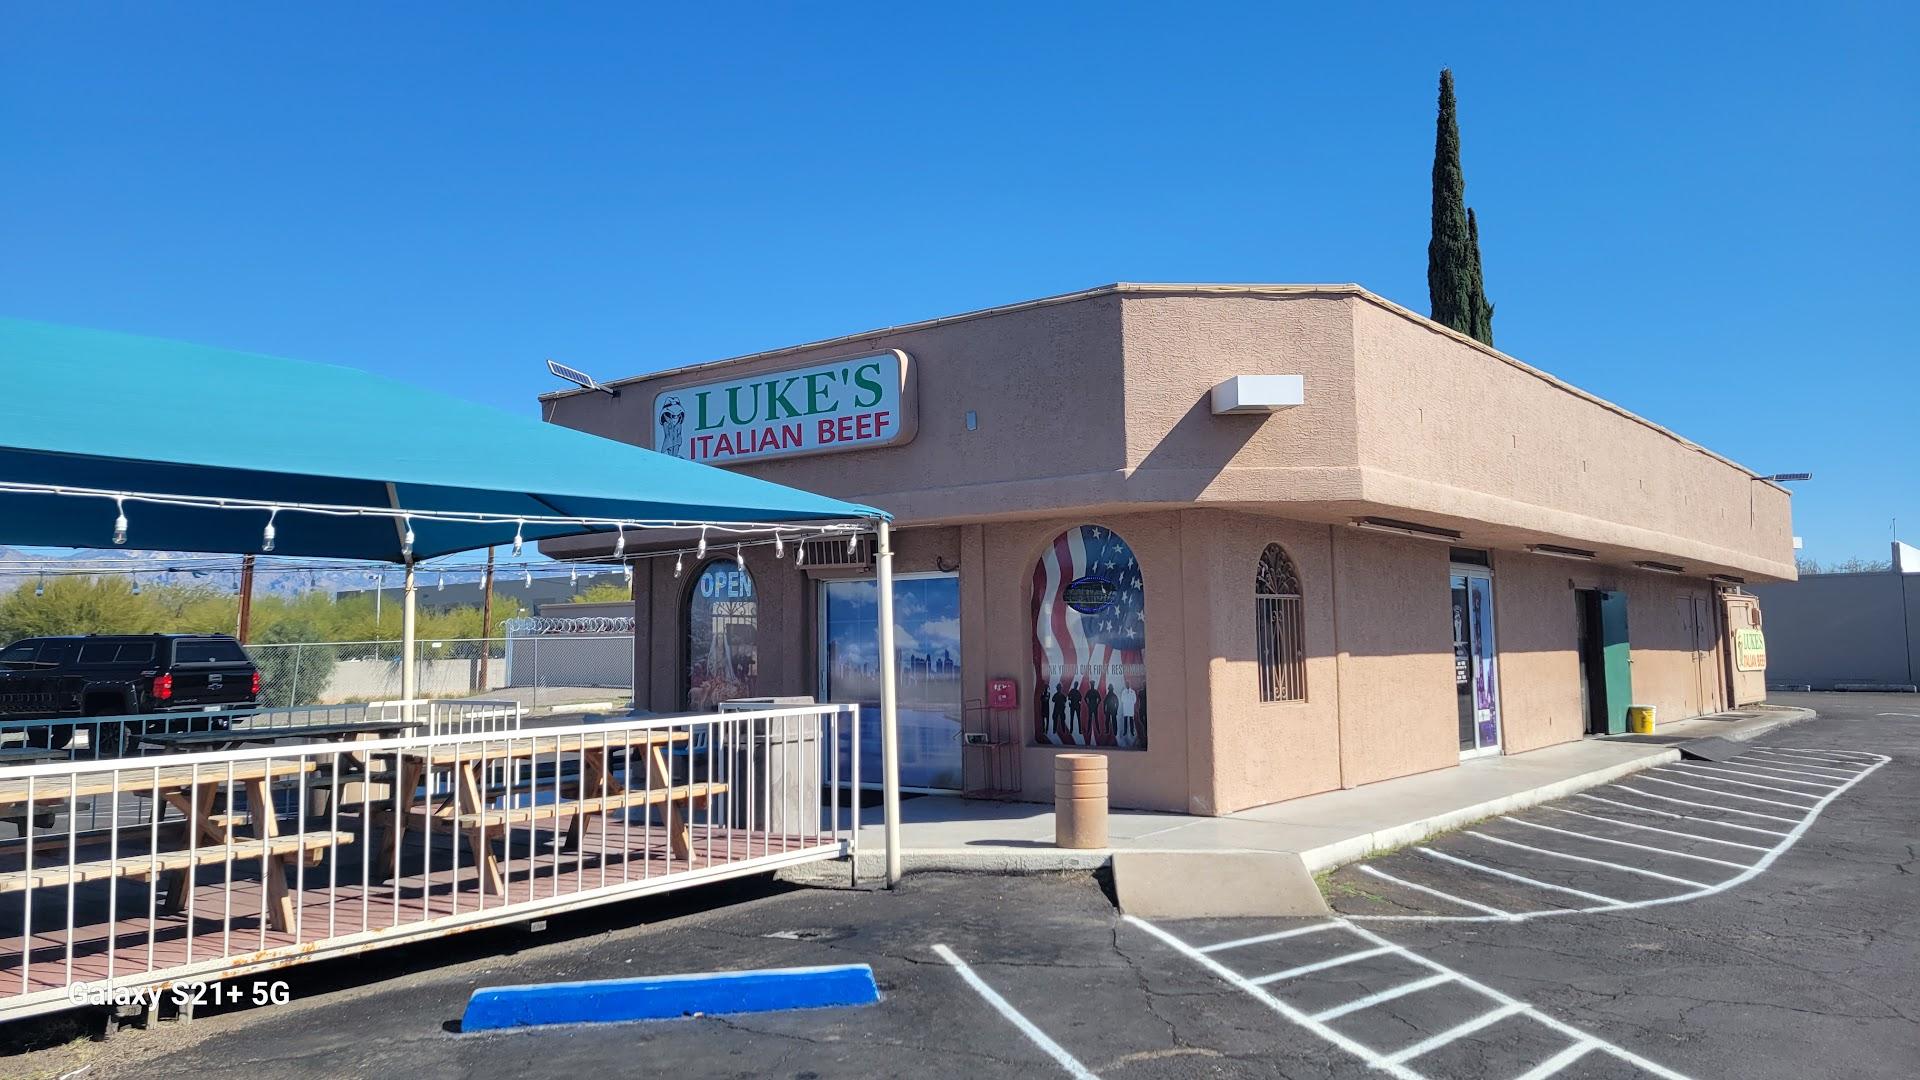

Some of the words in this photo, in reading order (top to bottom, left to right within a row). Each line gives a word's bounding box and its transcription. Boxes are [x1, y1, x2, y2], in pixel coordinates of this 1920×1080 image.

[694, 362, 883, 431] LUKE'S
[690, 422, 803, 460] ITALIAN
[817, 411, 890, 444] BEEF
[701, 571, 752, 598] OPEN
